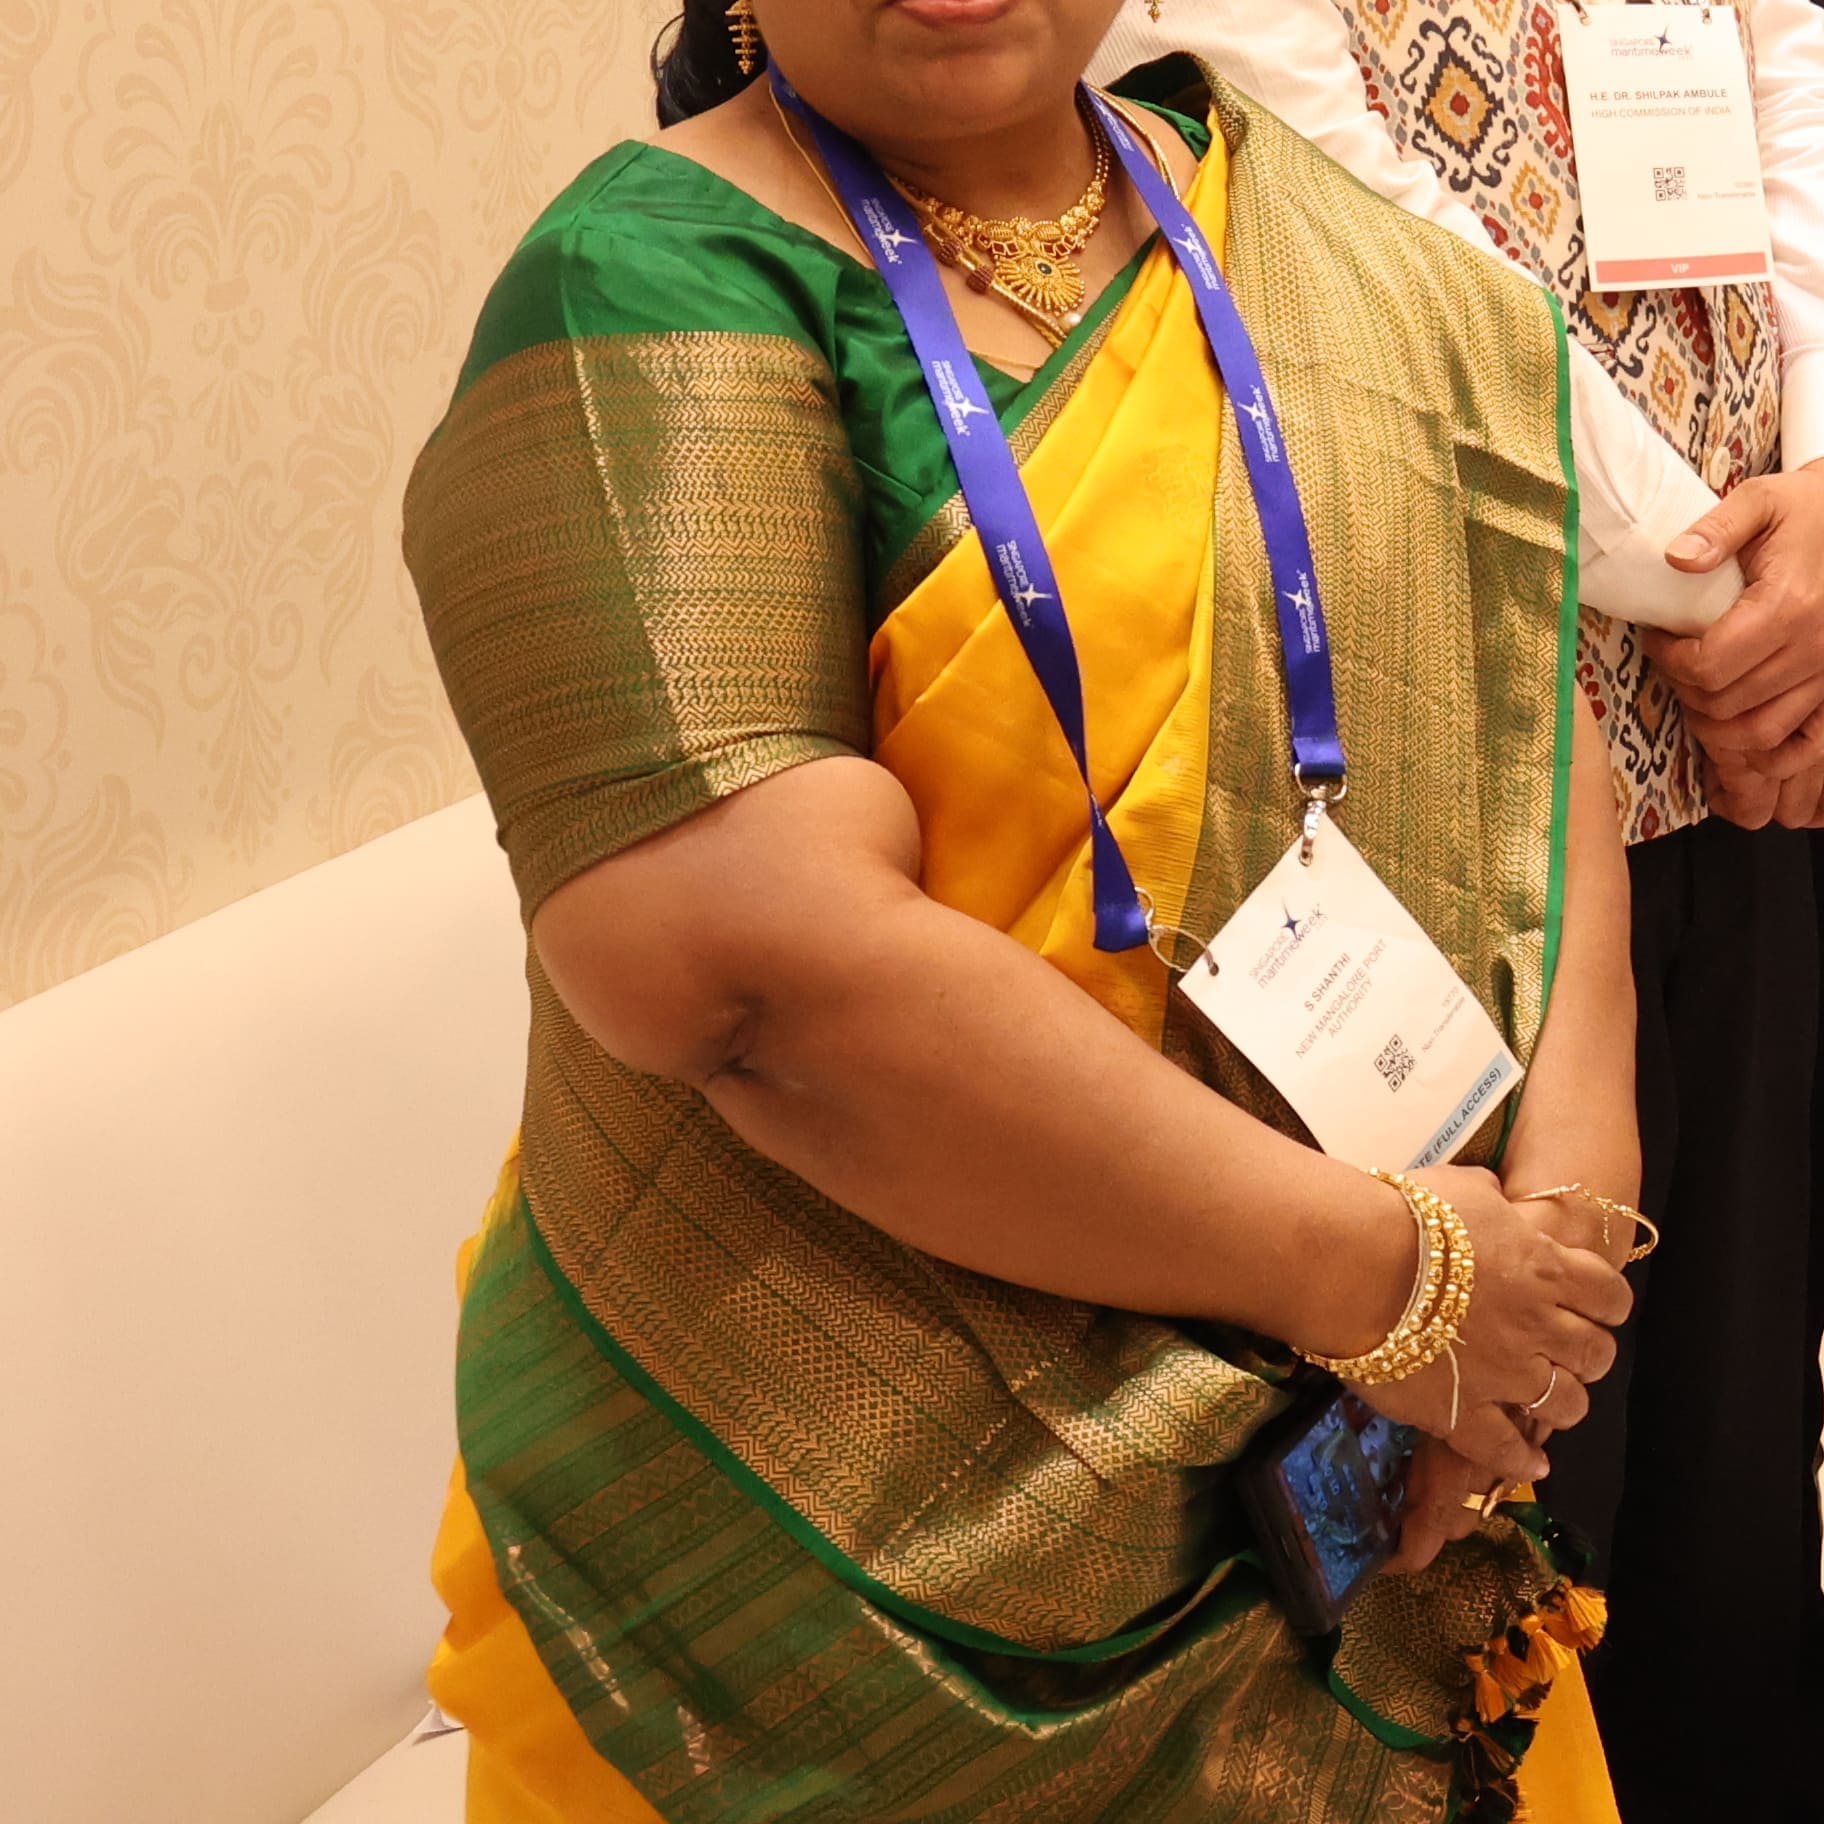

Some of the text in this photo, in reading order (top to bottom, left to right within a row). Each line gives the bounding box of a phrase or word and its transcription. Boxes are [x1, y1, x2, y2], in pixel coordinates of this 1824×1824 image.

[1619, 107, 1686, 118] COMMISSION
[1704, 106, 1732, 116] INDIA
[1635, 90, 1681, 100] SHILPAK
[1683, 88, 1728, 99] AMBULE
[1671, 263, 1690, 274] VIP
[1295, 938, 1388, 1058] NEW MANGALORE PORT
[1304, 952, 1351, 1012] S SHANTHI
[1327, 977, 1373, 1039] AUTHORITY
[1433, 1119, 1463, 1155] (FULL
[1461, 1066, 1502, 1121] ACCESS)
